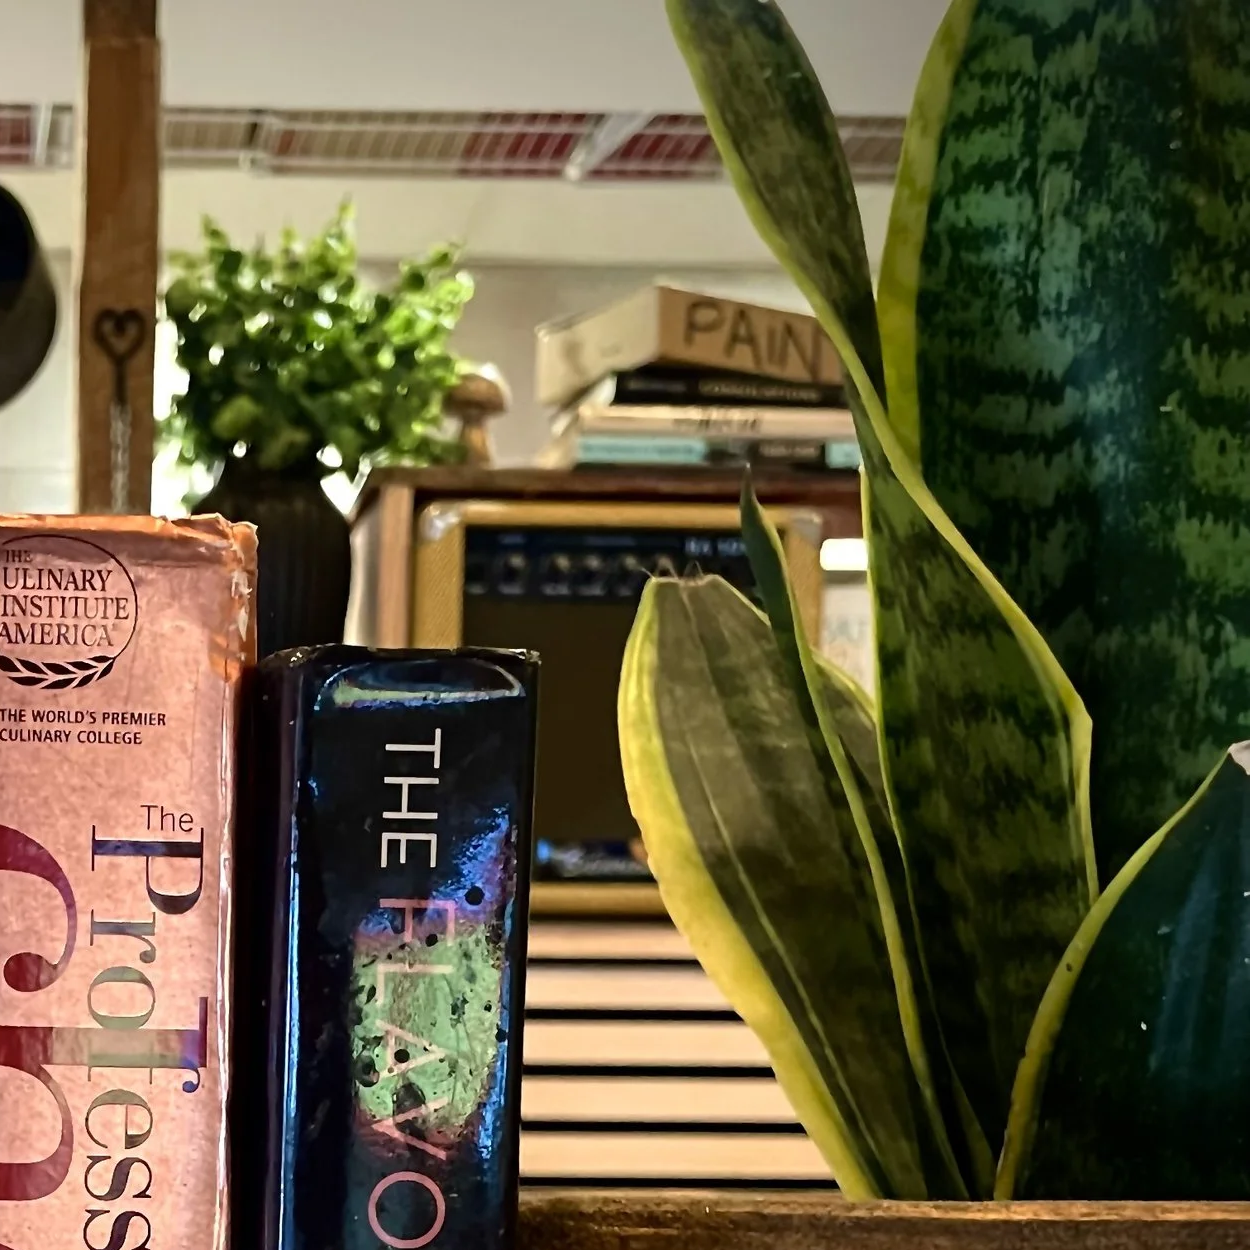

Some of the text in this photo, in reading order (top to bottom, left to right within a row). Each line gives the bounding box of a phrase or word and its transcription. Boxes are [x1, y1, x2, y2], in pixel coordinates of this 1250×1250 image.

[5, 550, 33, 563] THE
[1, 594, 129, 620] INSTITUTE
[0, 622, 114, 647] AMERICA
[0, 708, 166, 726] THE WORLD'S PREMIER
[0, 728, 142, 745] CULINARY COLLEGE
[380, 728, 441, 868] THE
[140, 804, 194, 832] The
